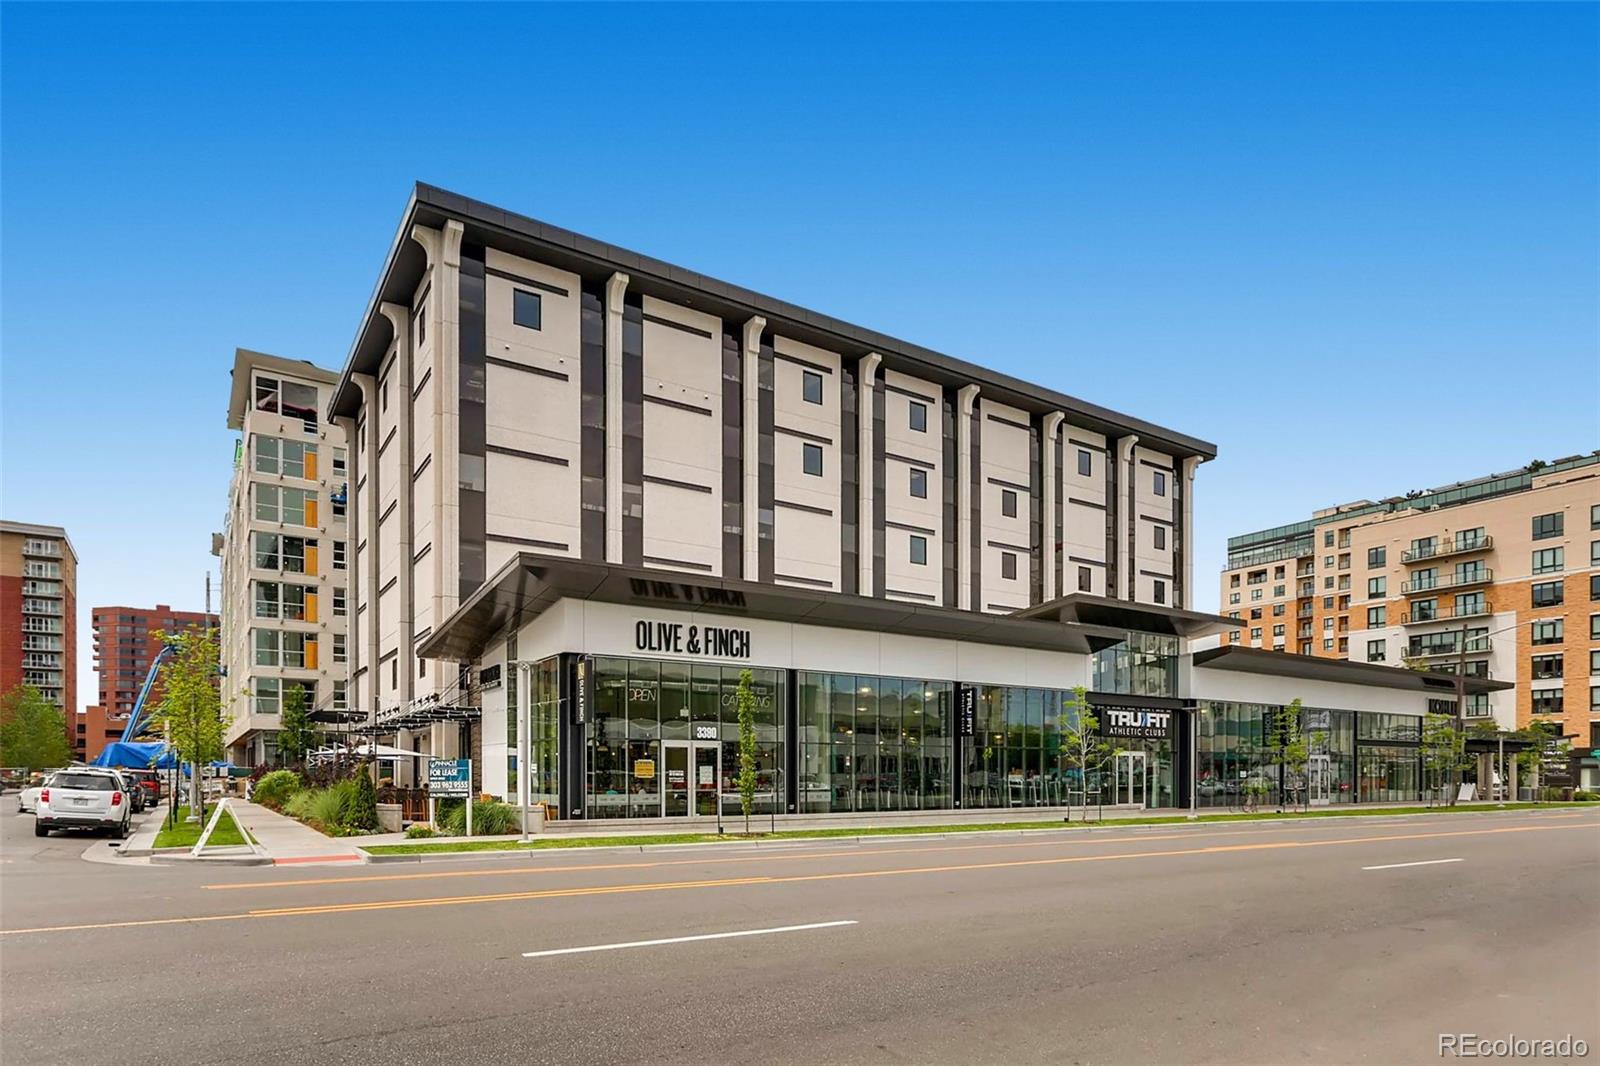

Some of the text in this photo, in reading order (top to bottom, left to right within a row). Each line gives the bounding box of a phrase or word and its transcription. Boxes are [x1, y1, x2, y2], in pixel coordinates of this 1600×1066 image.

[636, 620, 750, 658] OLIVE & FINCH
[629, 688, 657, 701] OPEN
[1109, 727, 1166, 737] ATHLETIC CLUBS
[429, 769, 458, 777] FOR LEASE
